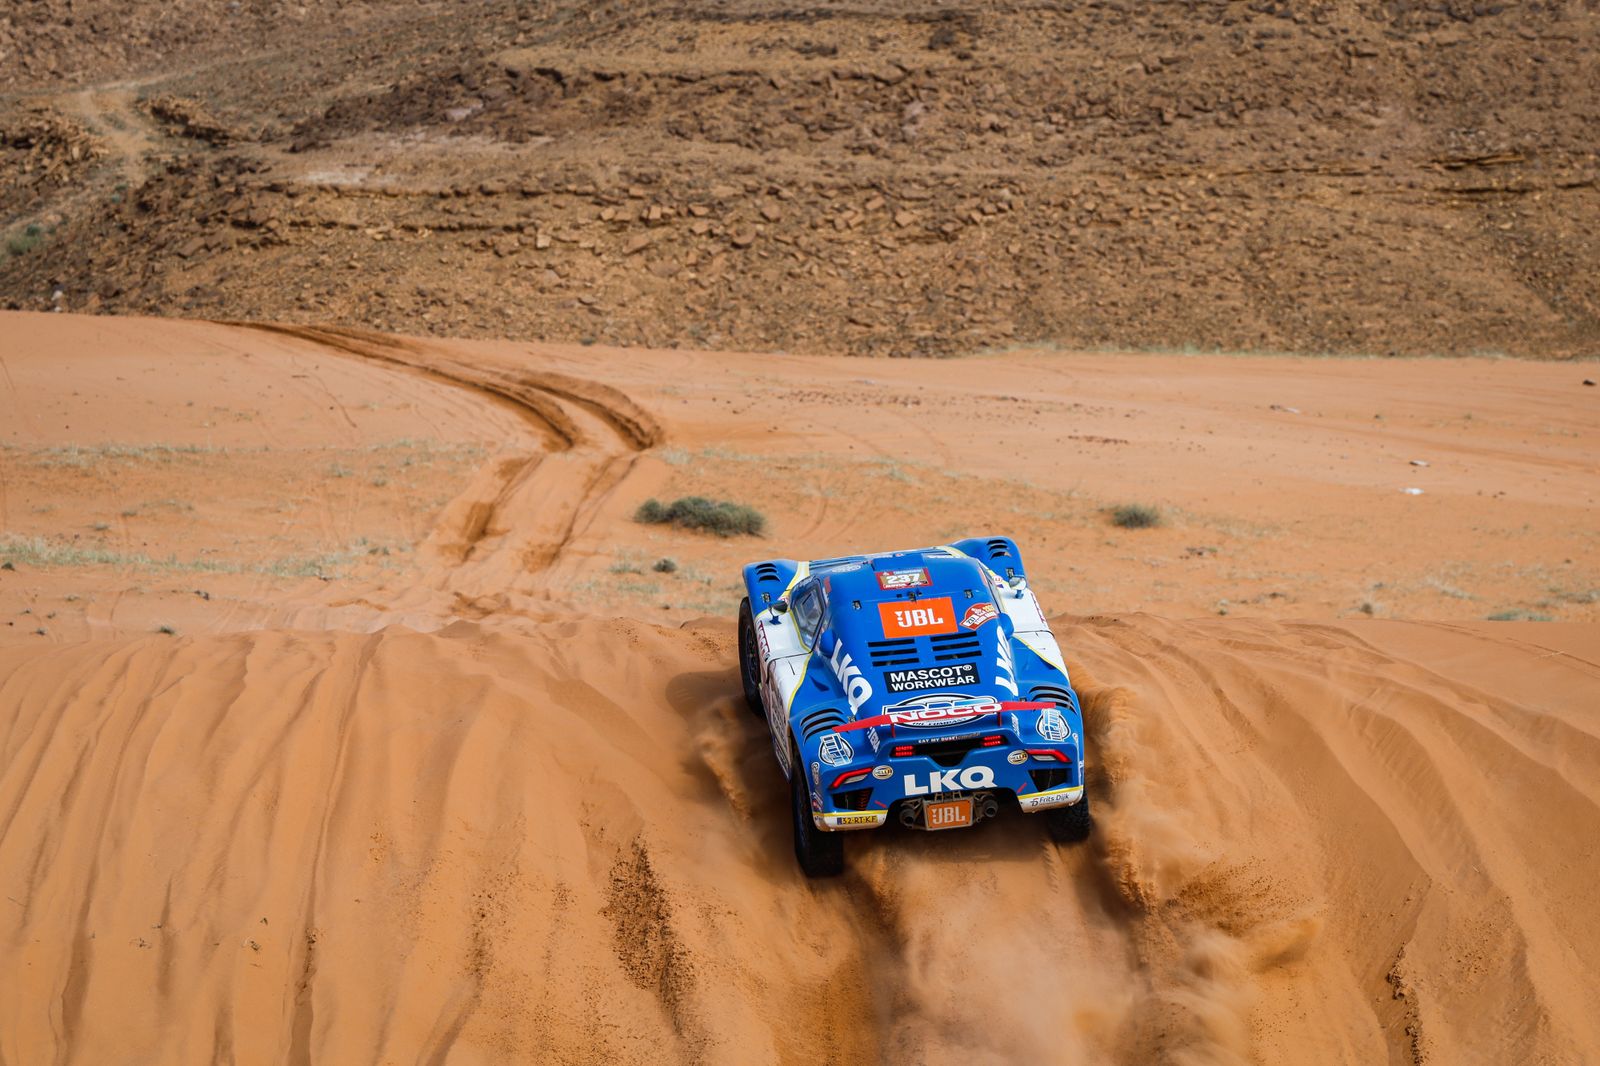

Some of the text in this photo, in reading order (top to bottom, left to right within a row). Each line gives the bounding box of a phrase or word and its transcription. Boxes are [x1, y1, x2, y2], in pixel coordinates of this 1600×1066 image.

[886, 573, 920, 585] 237
[895, 608, 944, 628] JBL
[995, 625, 1019, 696] LKQ
[830, 638, 873, 715] LKQ
[891, 675, 976, 692] WORKWEAR
[889, 702, 1003, 723] NOCO
[903, 765, 998, 796] LKQ
[1039, 794, 1070, 804] Frits Dijk
[931, 806, 966, 825] JBL
